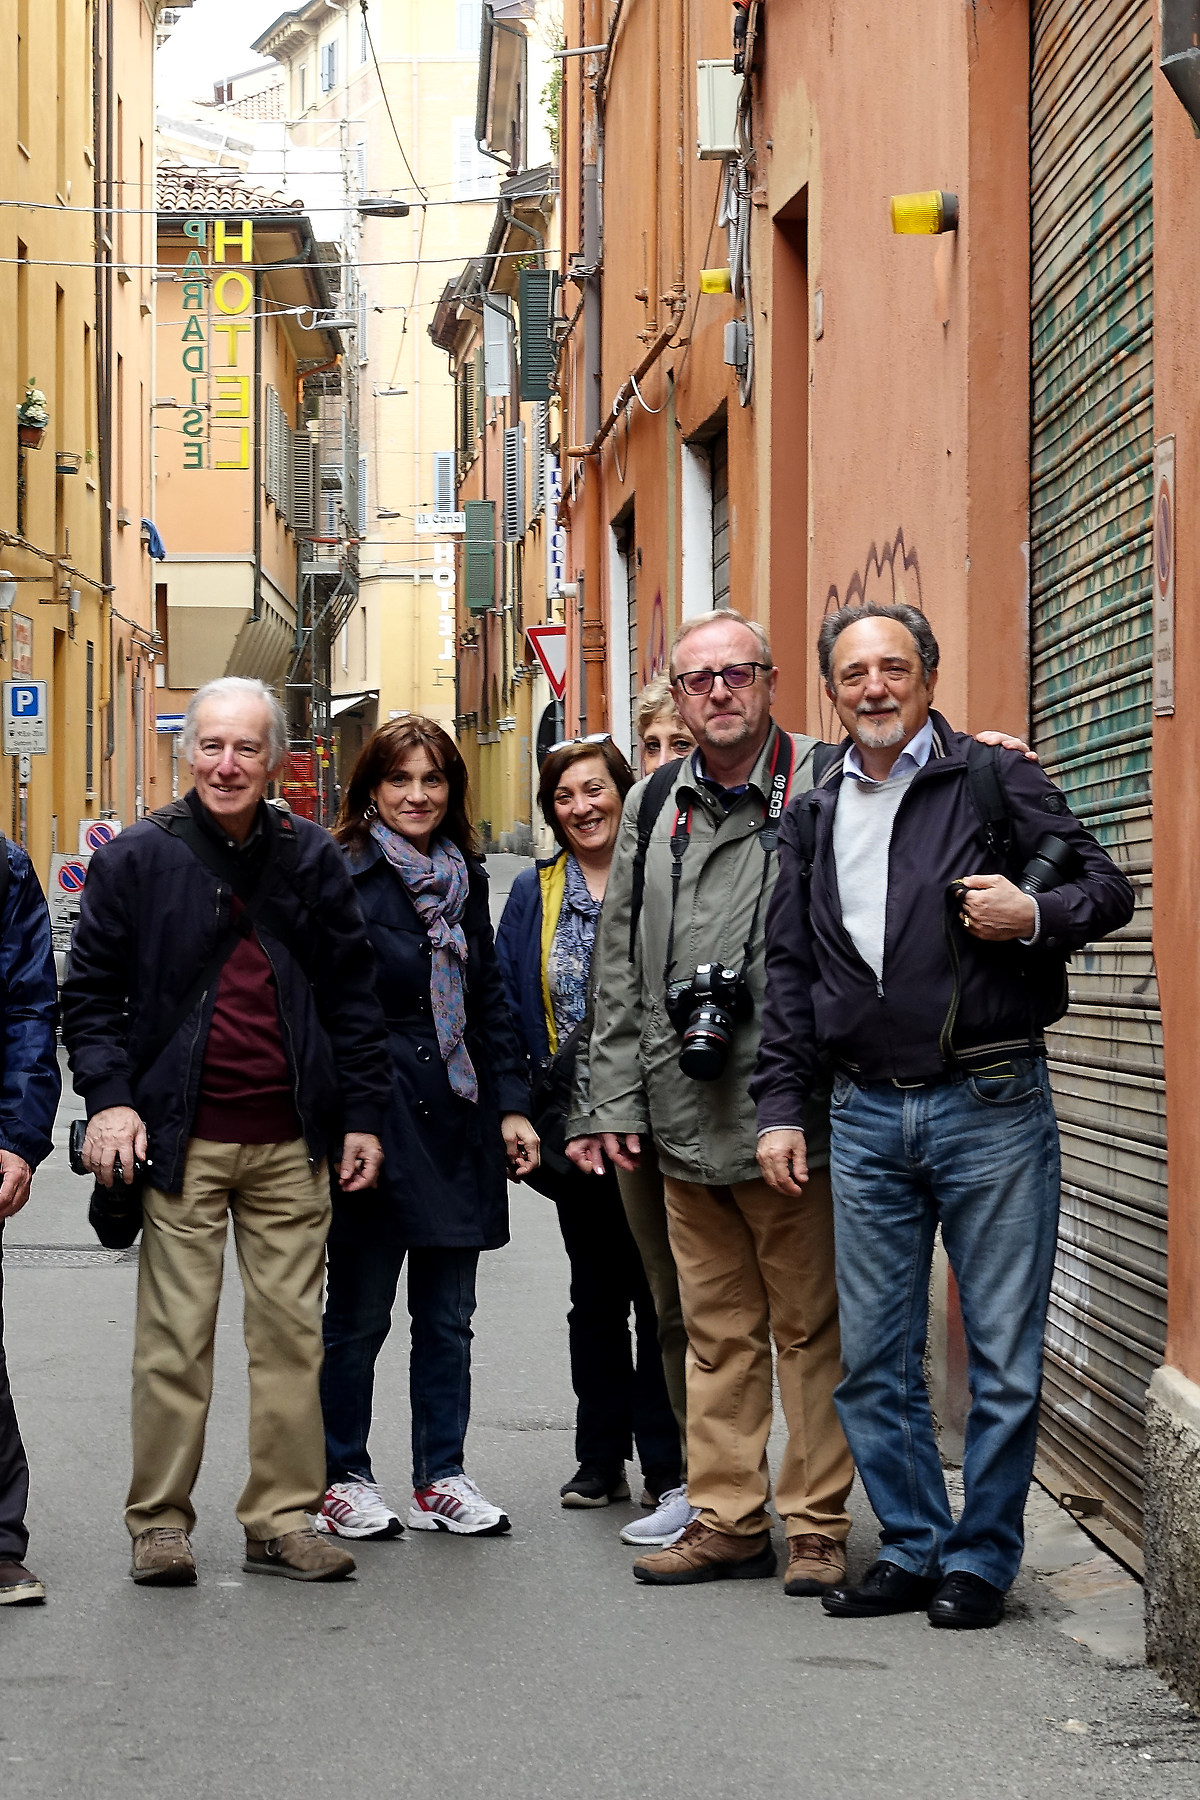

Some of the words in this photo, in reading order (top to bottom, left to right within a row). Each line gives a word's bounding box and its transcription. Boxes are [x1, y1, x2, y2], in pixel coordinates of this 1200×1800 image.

[16, 690, 34, 713] P
[774, 774, 786, 790] 6D
[768, 790, 783, 818] EOS
